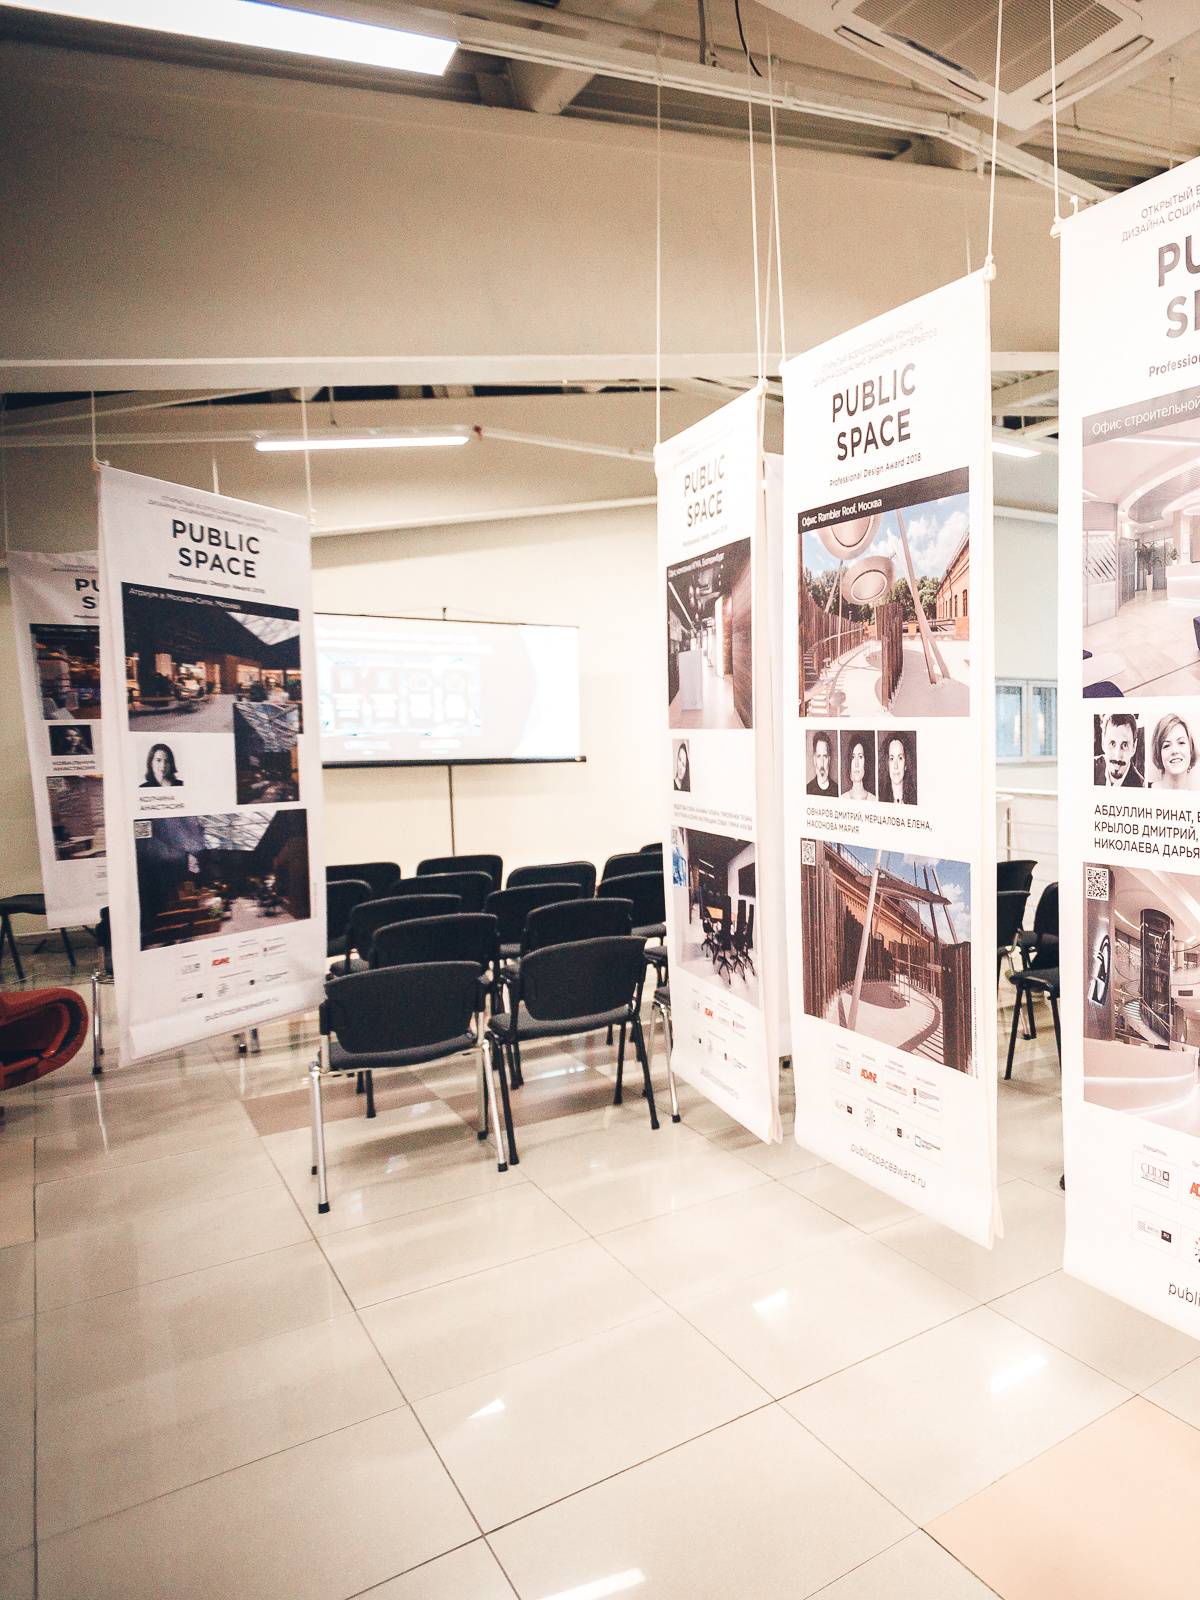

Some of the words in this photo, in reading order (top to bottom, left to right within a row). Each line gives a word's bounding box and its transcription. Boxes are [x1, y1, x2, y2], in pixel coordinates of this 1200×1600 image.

[1141, 187, 1194, 219] ОТКРЫТЫЙ
[1121, 215, 1165, 244] ДИЗАЙНА
[832, 363, 916, 423] PUBLIC
[837, 408, 911, 461] SPACE
[1092, 417, 1122, 436] Офис
[685, 455, 725, 497] PUBLIC
[829, 471, 862, 488] Professional
[863, 466, 884, 479] Design
[885, 458, 905, 471] Award
[906, 453, 921, 465] 2018
[687, 490, 723, 527] SPACE
[818, 508, 841, 521] Rambler
[858, 498, 882, 511] Москва
[172, 519, 260, 555] PUBLIC
[179, 547, 256, 578] SPACE
[806, 807, 834, 817] ОВЧАРОВ
[834, 810, 864, 822] ДМИТРИЙ,
[864, 814, 906, 827] МЕРЦАЛОВА
[907, 818, 933, 832] ЕЛЕНА,
[806, 819, 838, 831] НАСОНОВА
[838, 824, 860, 834] МАРИЯ
[1094, 804, 1152, 819] АБДУЛЛИН
[1155, 809, 1194, 824] РИНАТ,
[1094, 821, 1139, 835] КРЫЛОВ
[1142, 824, 1199, 843] ДМИТРИЙ,
[1094, 838, 1160, 855] НИКОЛАЕВА
[850, 1142, 927, 1188] publicspaceaward.ru
